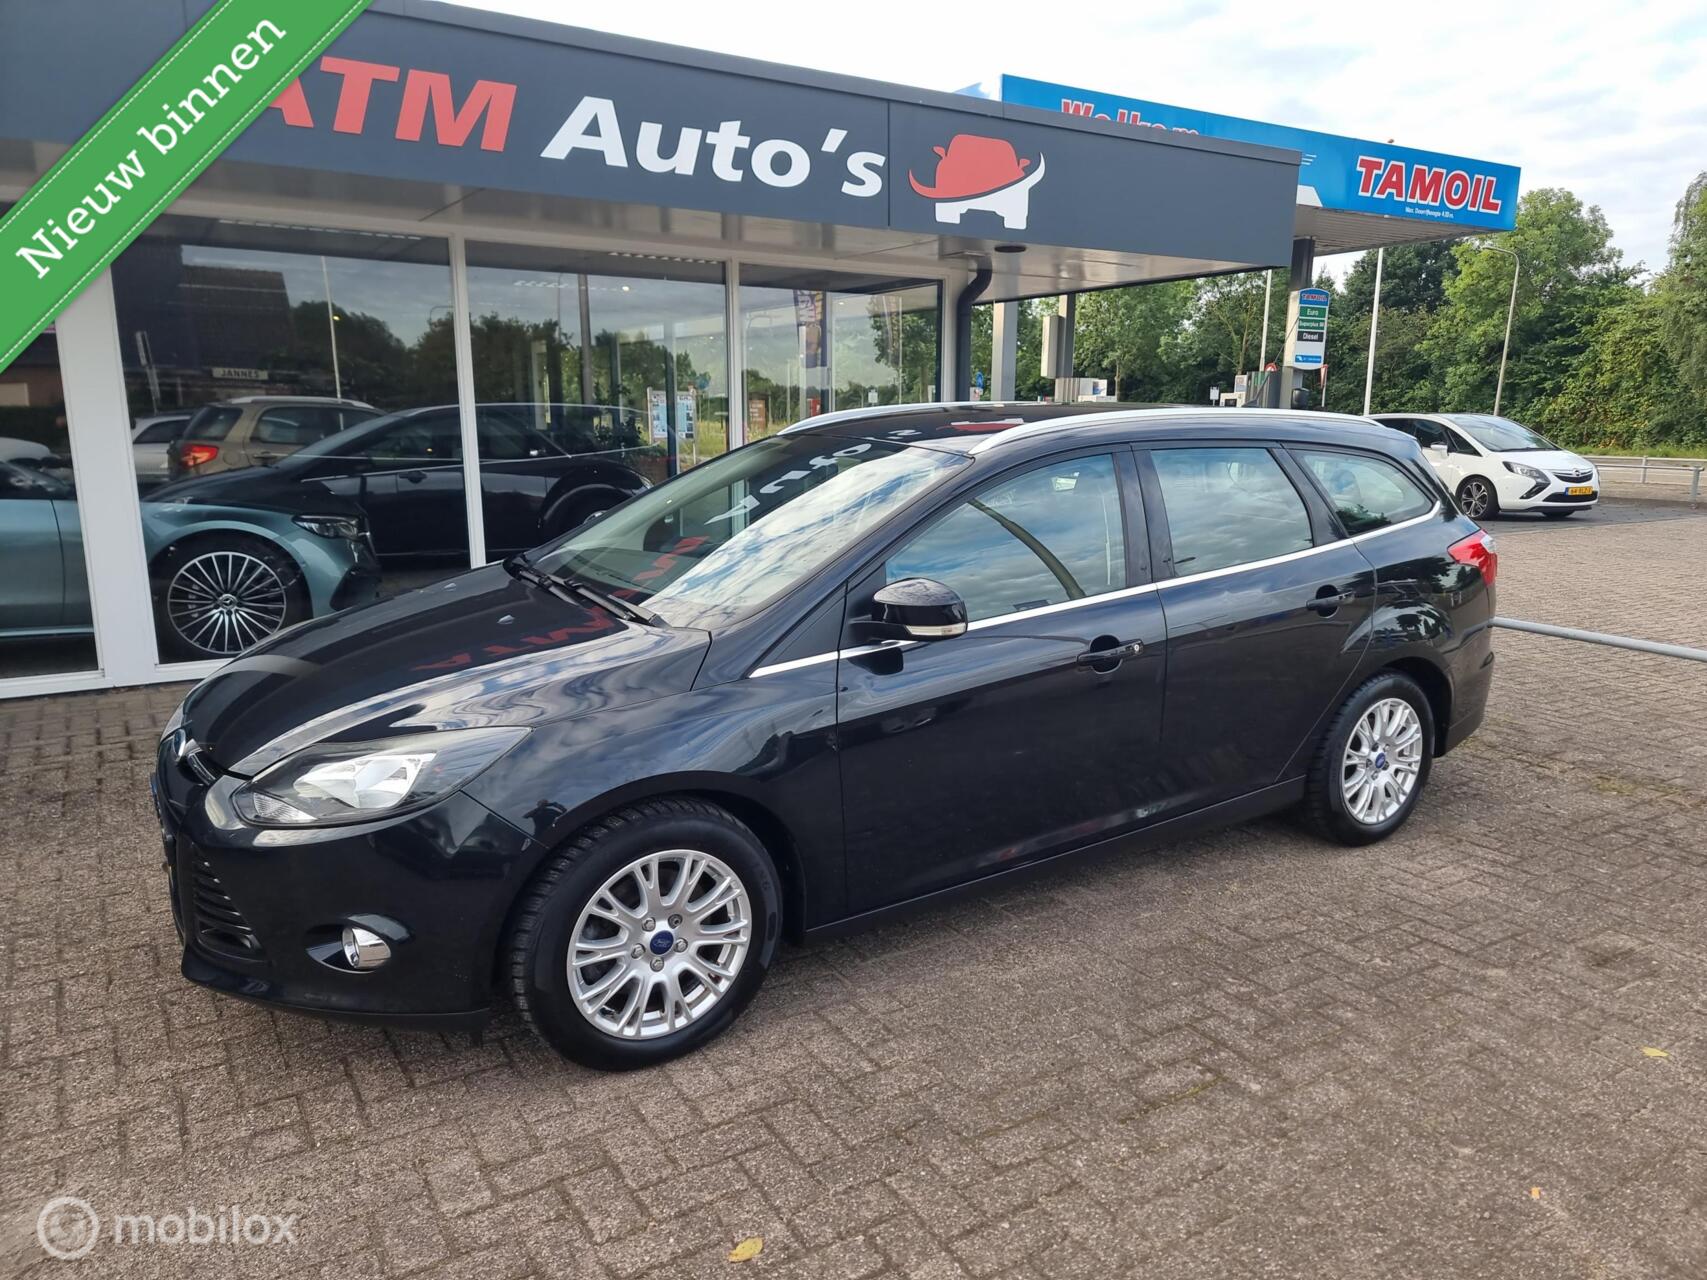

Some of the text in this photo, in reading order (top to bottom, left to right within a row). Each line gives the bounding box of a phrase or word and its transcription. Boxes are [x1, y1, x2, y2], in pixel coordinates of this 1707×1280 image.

[540, 95, 886, 198] Auto's
[1356, 155, 1502, 215] TAMOIL
[1306, 308, 1319, 316] Euro
[1302, 332, 1319, 340] Diesel
